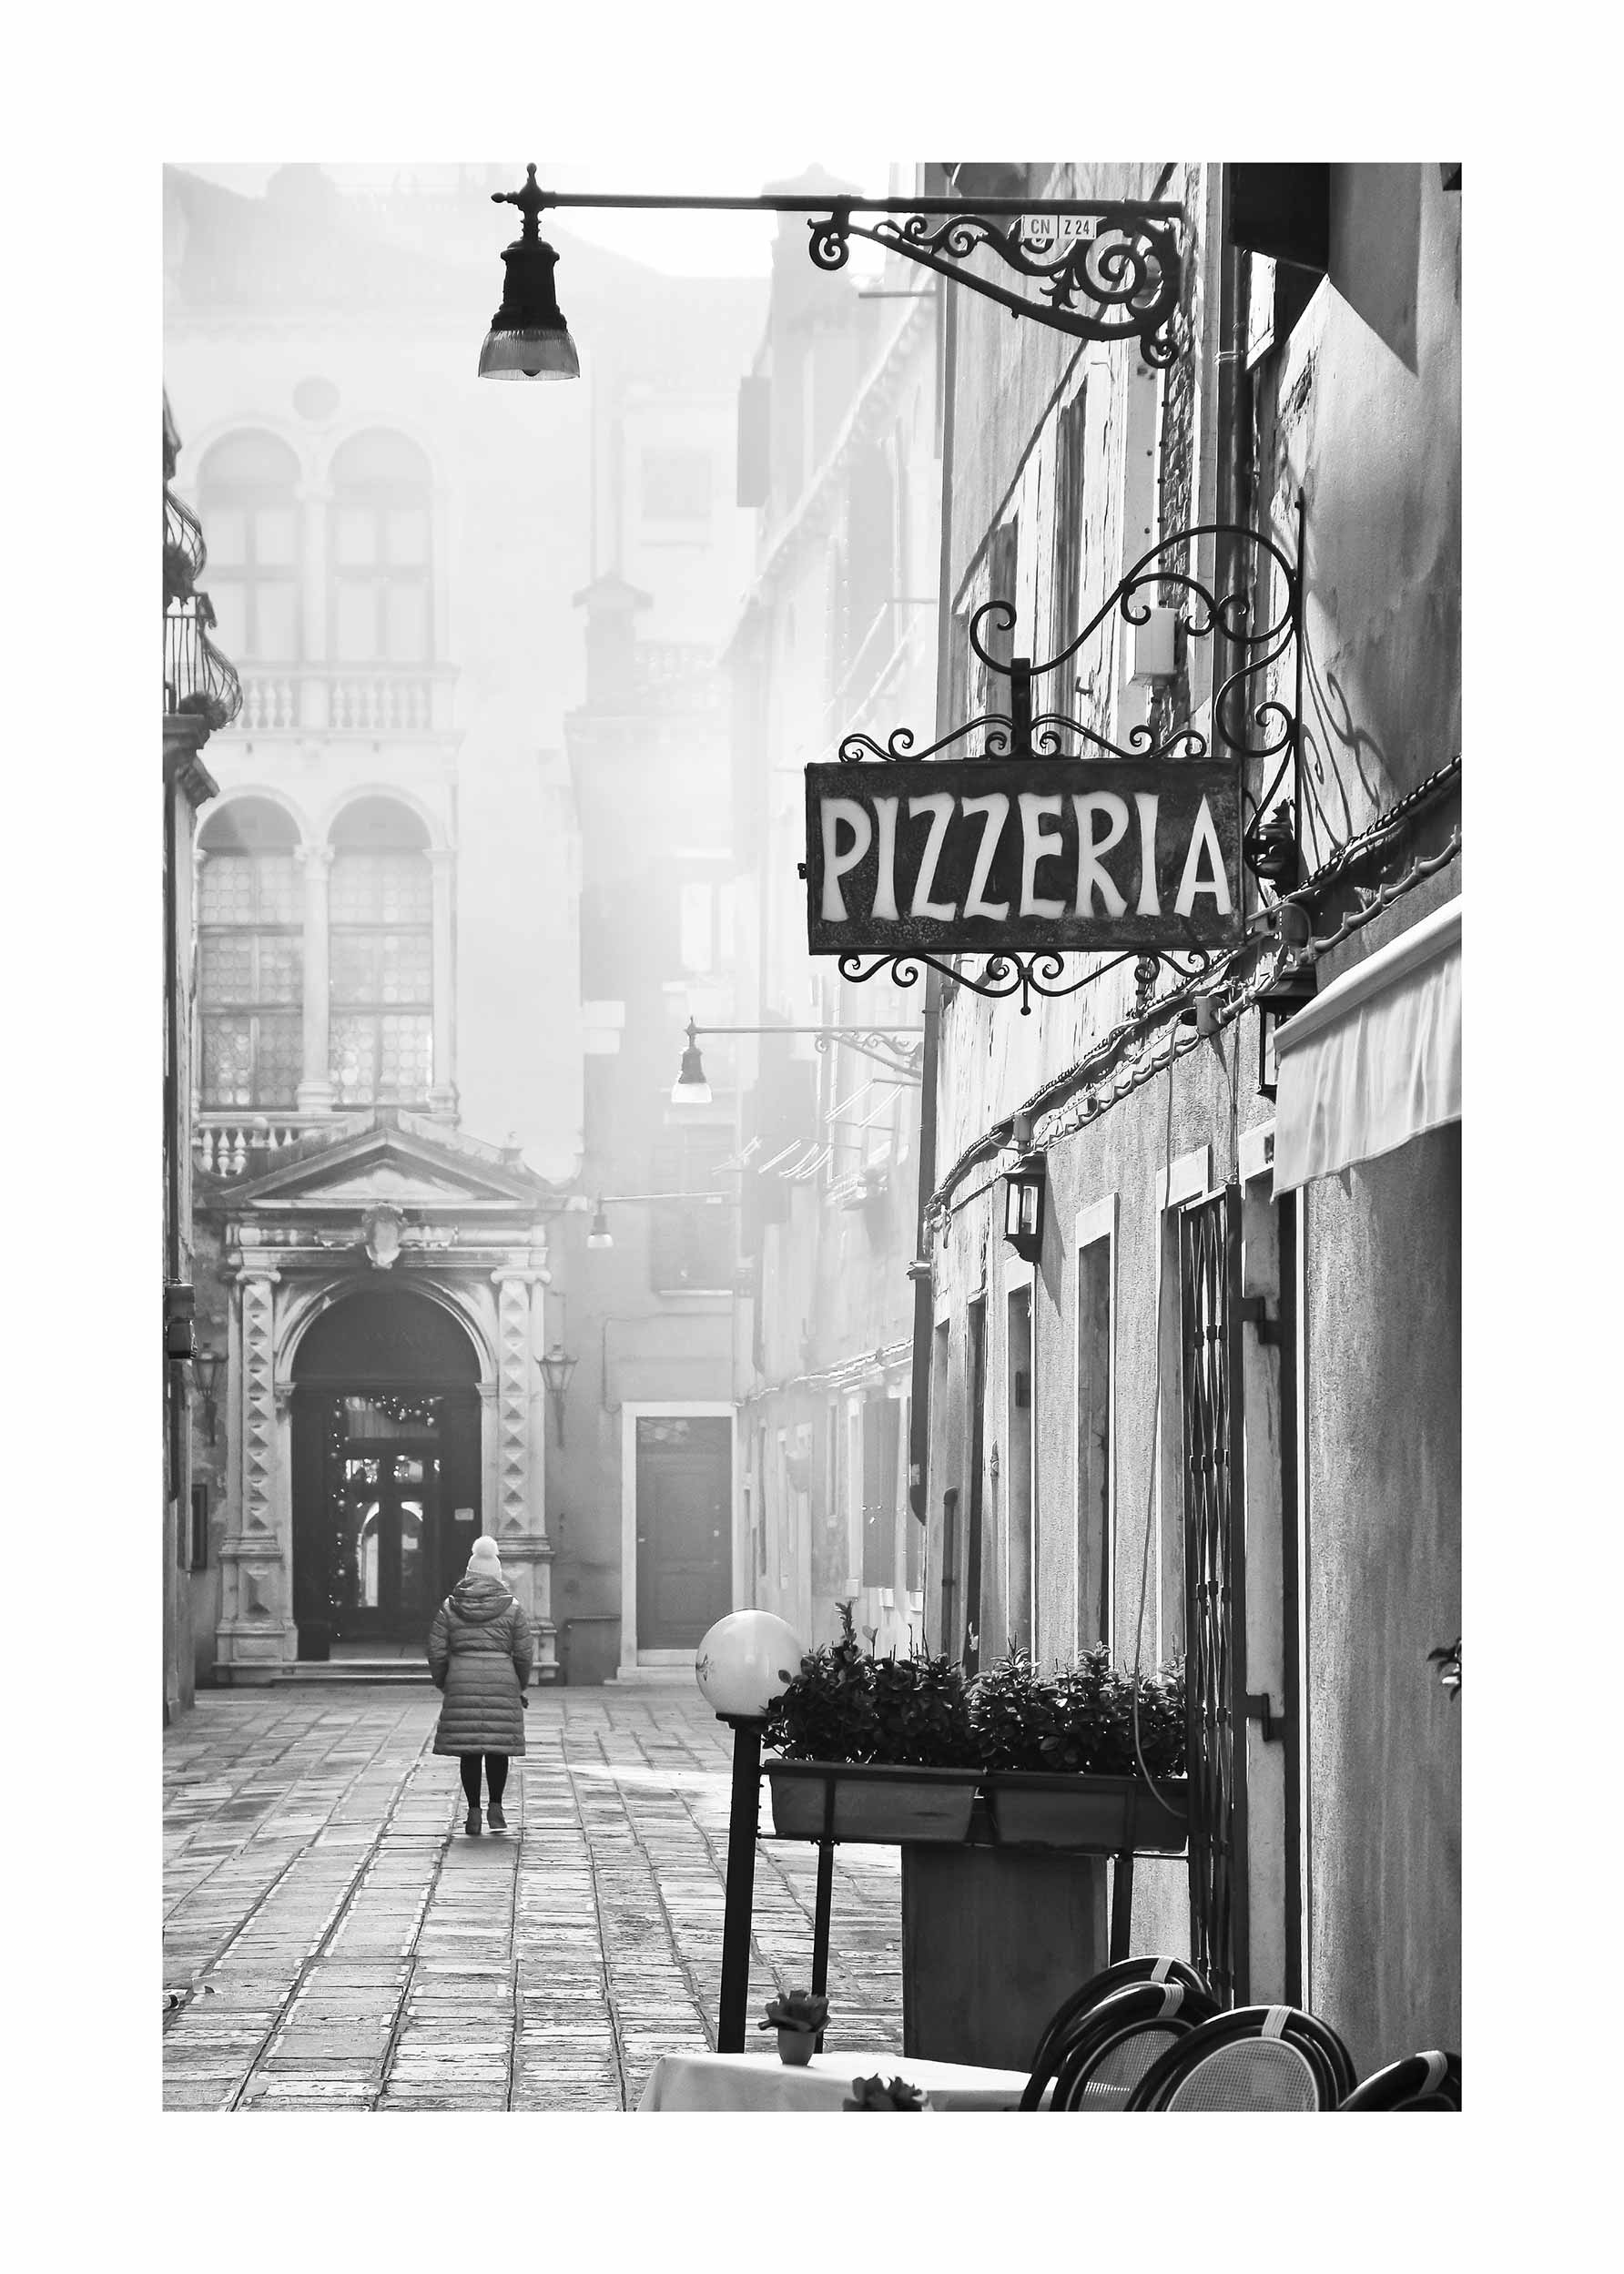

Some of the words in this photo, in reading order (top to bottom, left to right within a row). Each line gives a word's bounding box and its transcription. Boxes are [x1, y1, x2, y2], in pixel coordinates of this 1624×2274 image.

[1030, 218, 1051, 235] CN
[1064, 219, 1071, 235] Z
[1075, 219, 1090, 235] 24
[820, 791, 1233, 922] PIZZERIA
